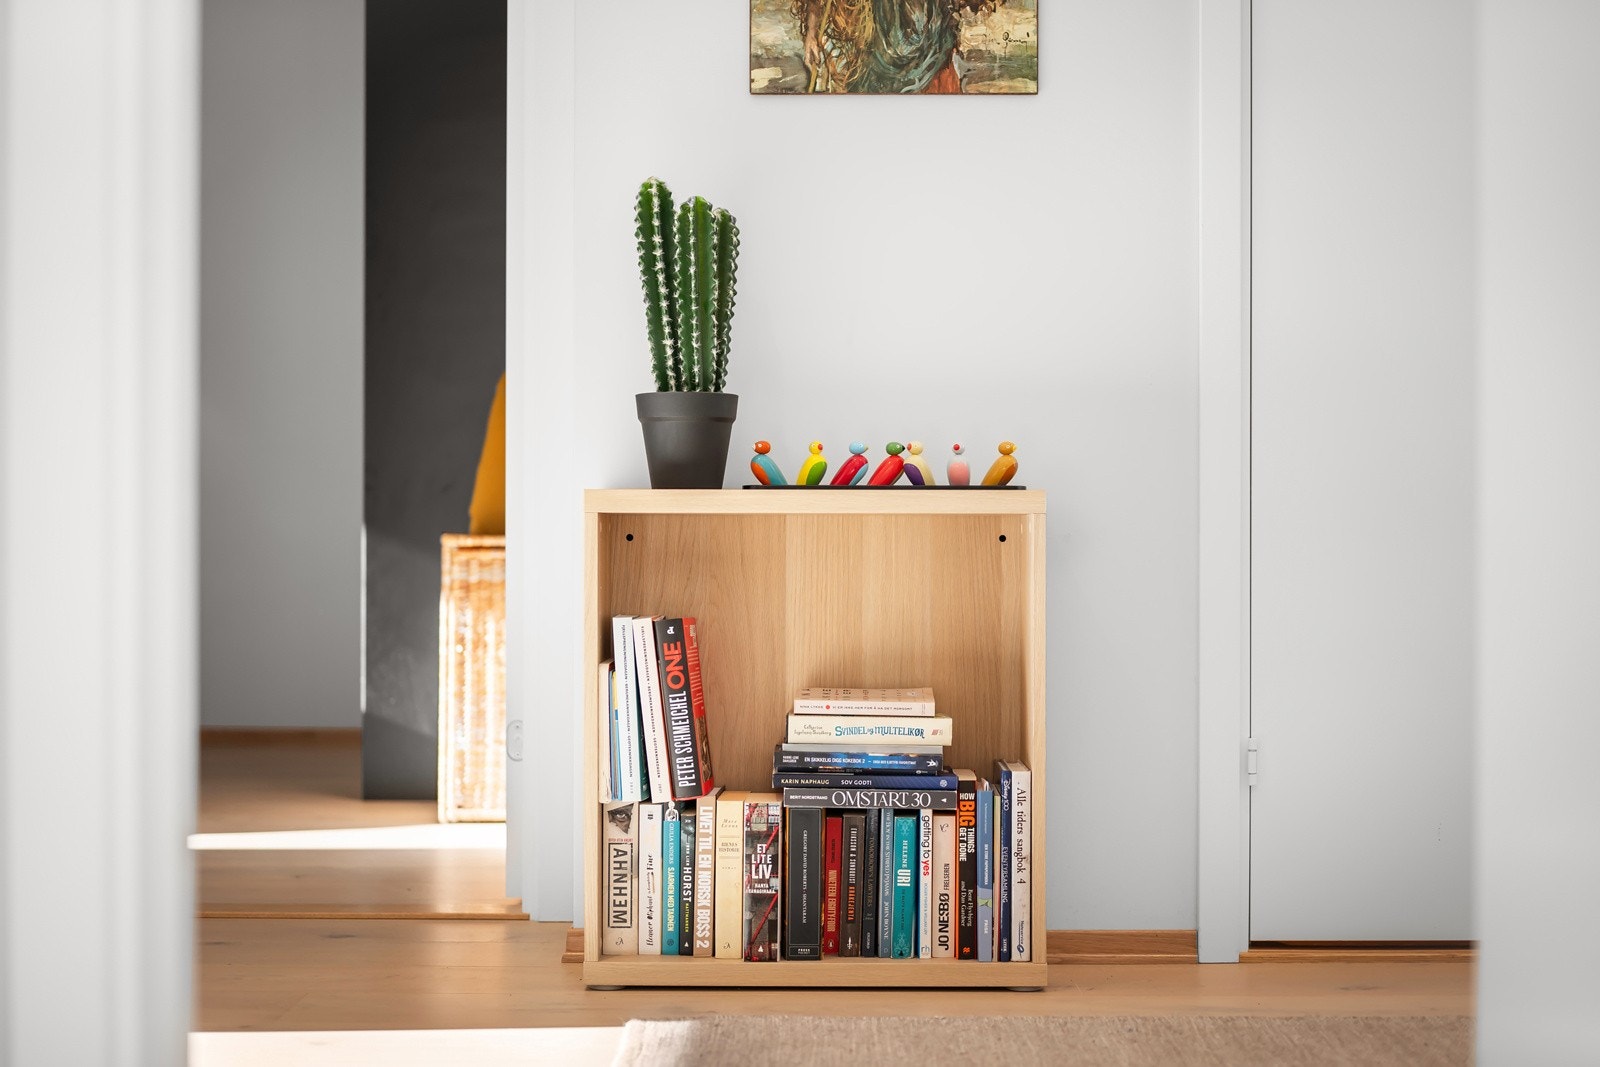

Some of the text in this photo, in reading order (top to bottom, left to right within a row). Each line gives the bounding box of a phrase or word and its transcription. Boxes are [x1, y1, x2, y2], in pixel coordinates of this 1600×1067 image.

[663, 641, 696, 787] PETER SCHMEICHEL ONE
[875, 726, 925, 739] MULTELIKØR
[832, 790, 910, 808] OMSTART
[911, 792, 931, 808] 30
[1017, 787, 1027, 806] Alle
[699, 806, 713, 834] LIVET
[959, 801, 976, 826] BIG
[1017, 811, 1026, 835] tiders
[699, 836, 713, 851] TIL
[757, 843, 768, 853] ET
[849, 828, 857, 851] ERIKSSON
[921, 815, 931, 876] getting to yes
[698, 854, 712, 868] EN
[751, 854, 773, 864] LITE
[1014, 838, 1026, 874] sangbok
[751, 864, 773, 879] LIV
[897, 869, 910, 887] URI
[683, 867, 692, 902] HORST
[697, 871, 712, 907] NORSK
[826, 870, 837, 932] NINETEEN EIGHTY-FOUR
[938, 893, 949, 933] NESBØ
[696, 940, 710, 949] 2
[938, 935, 949, 950] JO
